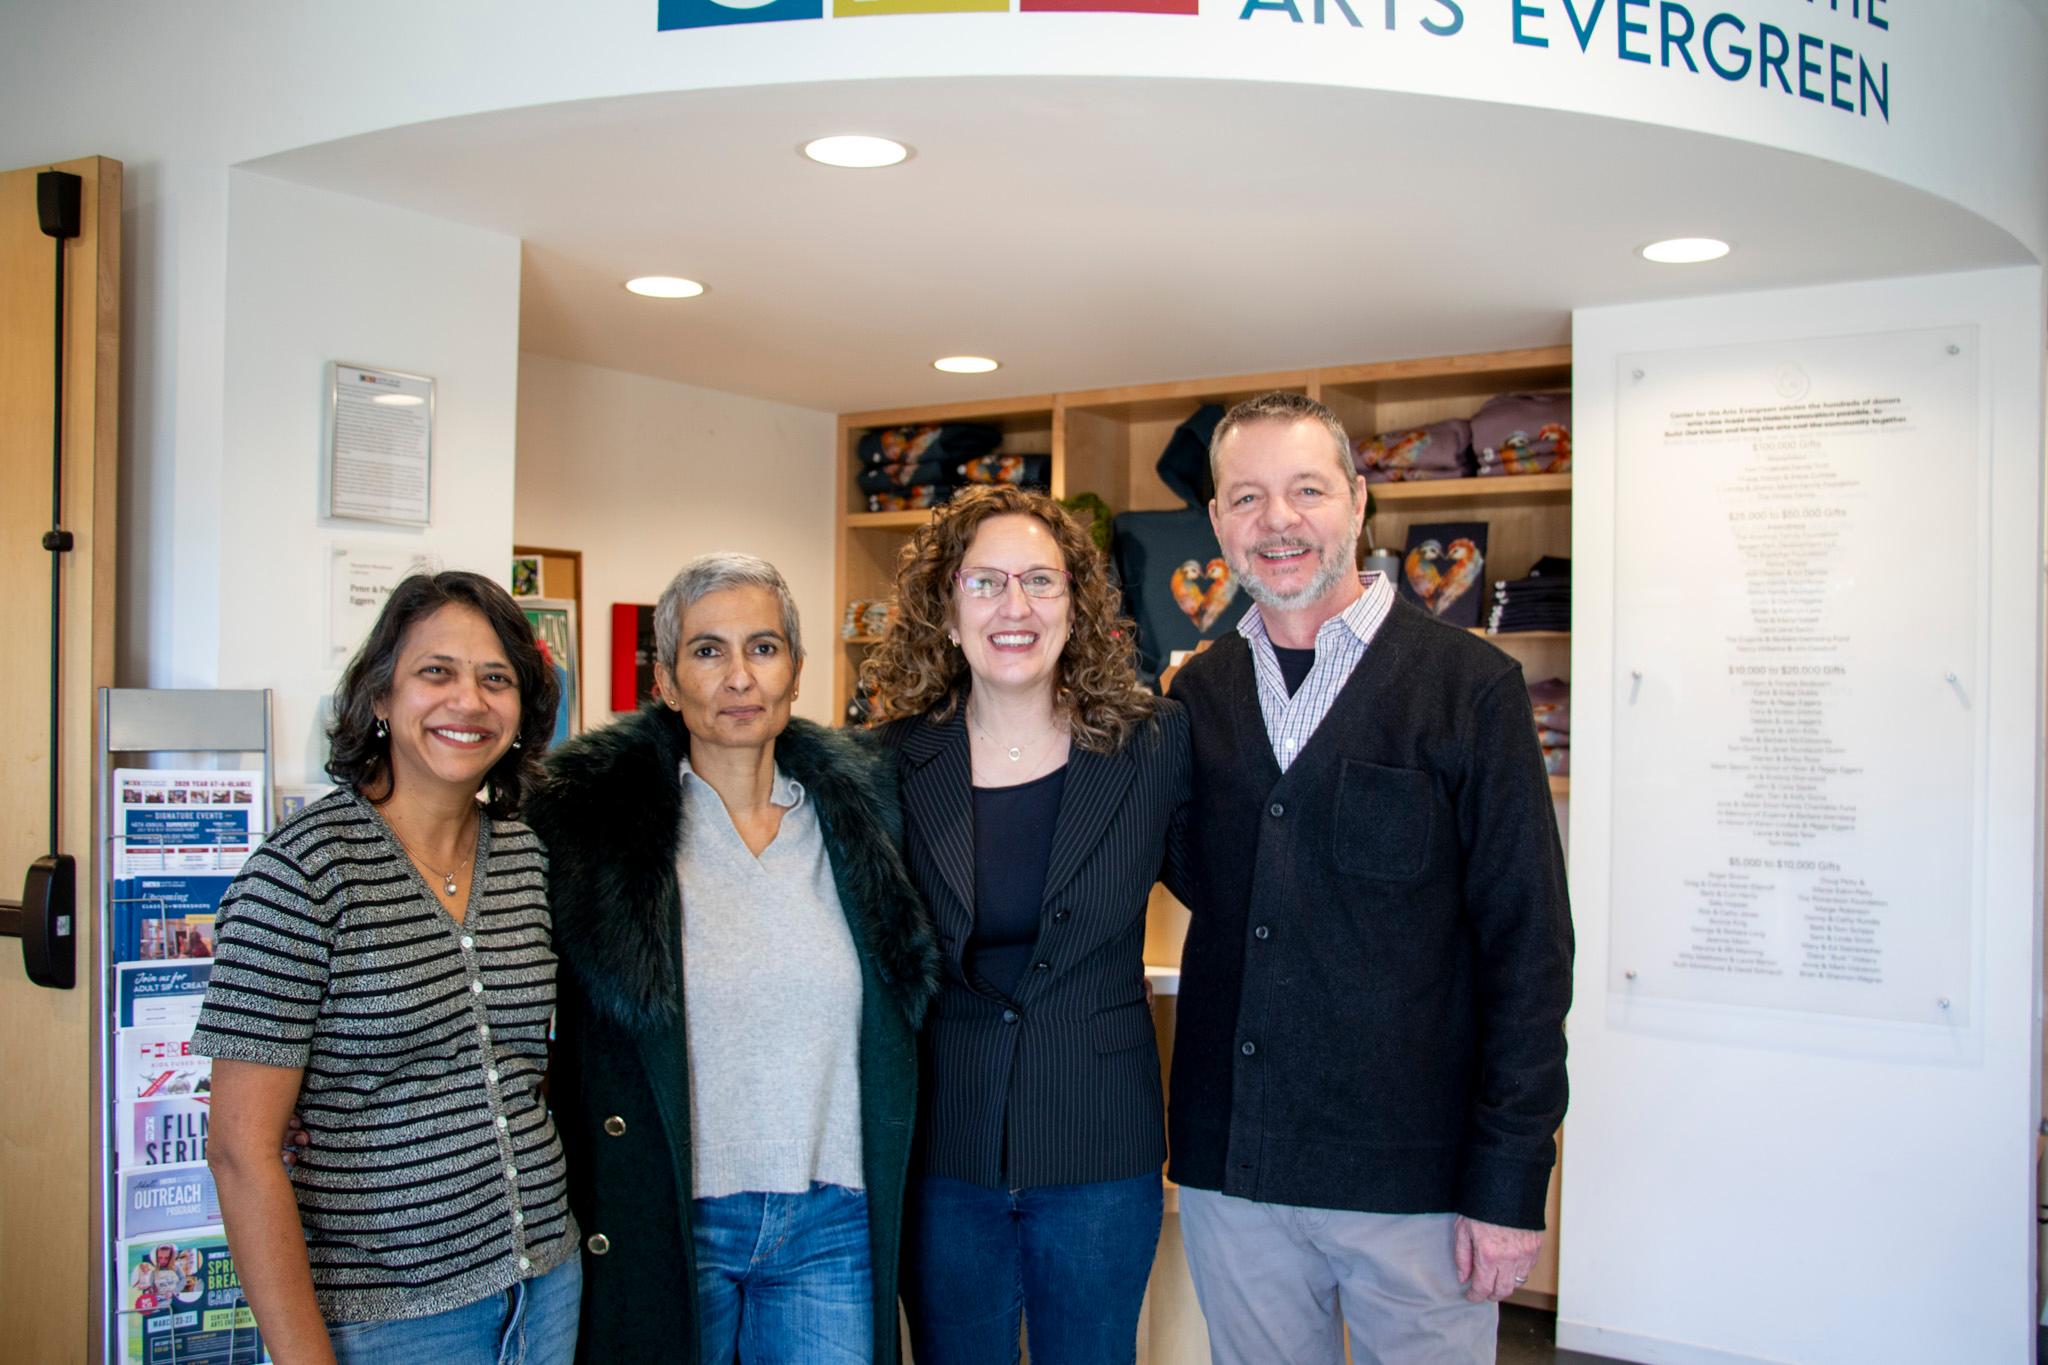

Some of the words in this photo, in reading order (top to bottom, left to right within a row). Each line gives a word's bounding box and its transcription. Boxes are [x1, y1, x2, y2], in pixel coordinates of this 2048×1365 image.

[1513, 0, 1889, 125] EVERGREEN
[196, 812, 223, 820] EVENTS
[1818, 861, 1841, 872] Gifts
[134, 973, 157, 985] Join
[159, 974, 171, 982] us
[170, 971, 188, 985] for
[133, 984, 159, 993] ADULT
[180, 980, 209, 991] CREAT
[146, 1138, 208, 1166] SERIE
[134, 1183, 202, 1210] OUTREACH
[166, 1204, 201, 1216] PROGRAMS
[208, 1259, 235, 1275] SPRI
[208, 1272, 241, 1290] BREA
